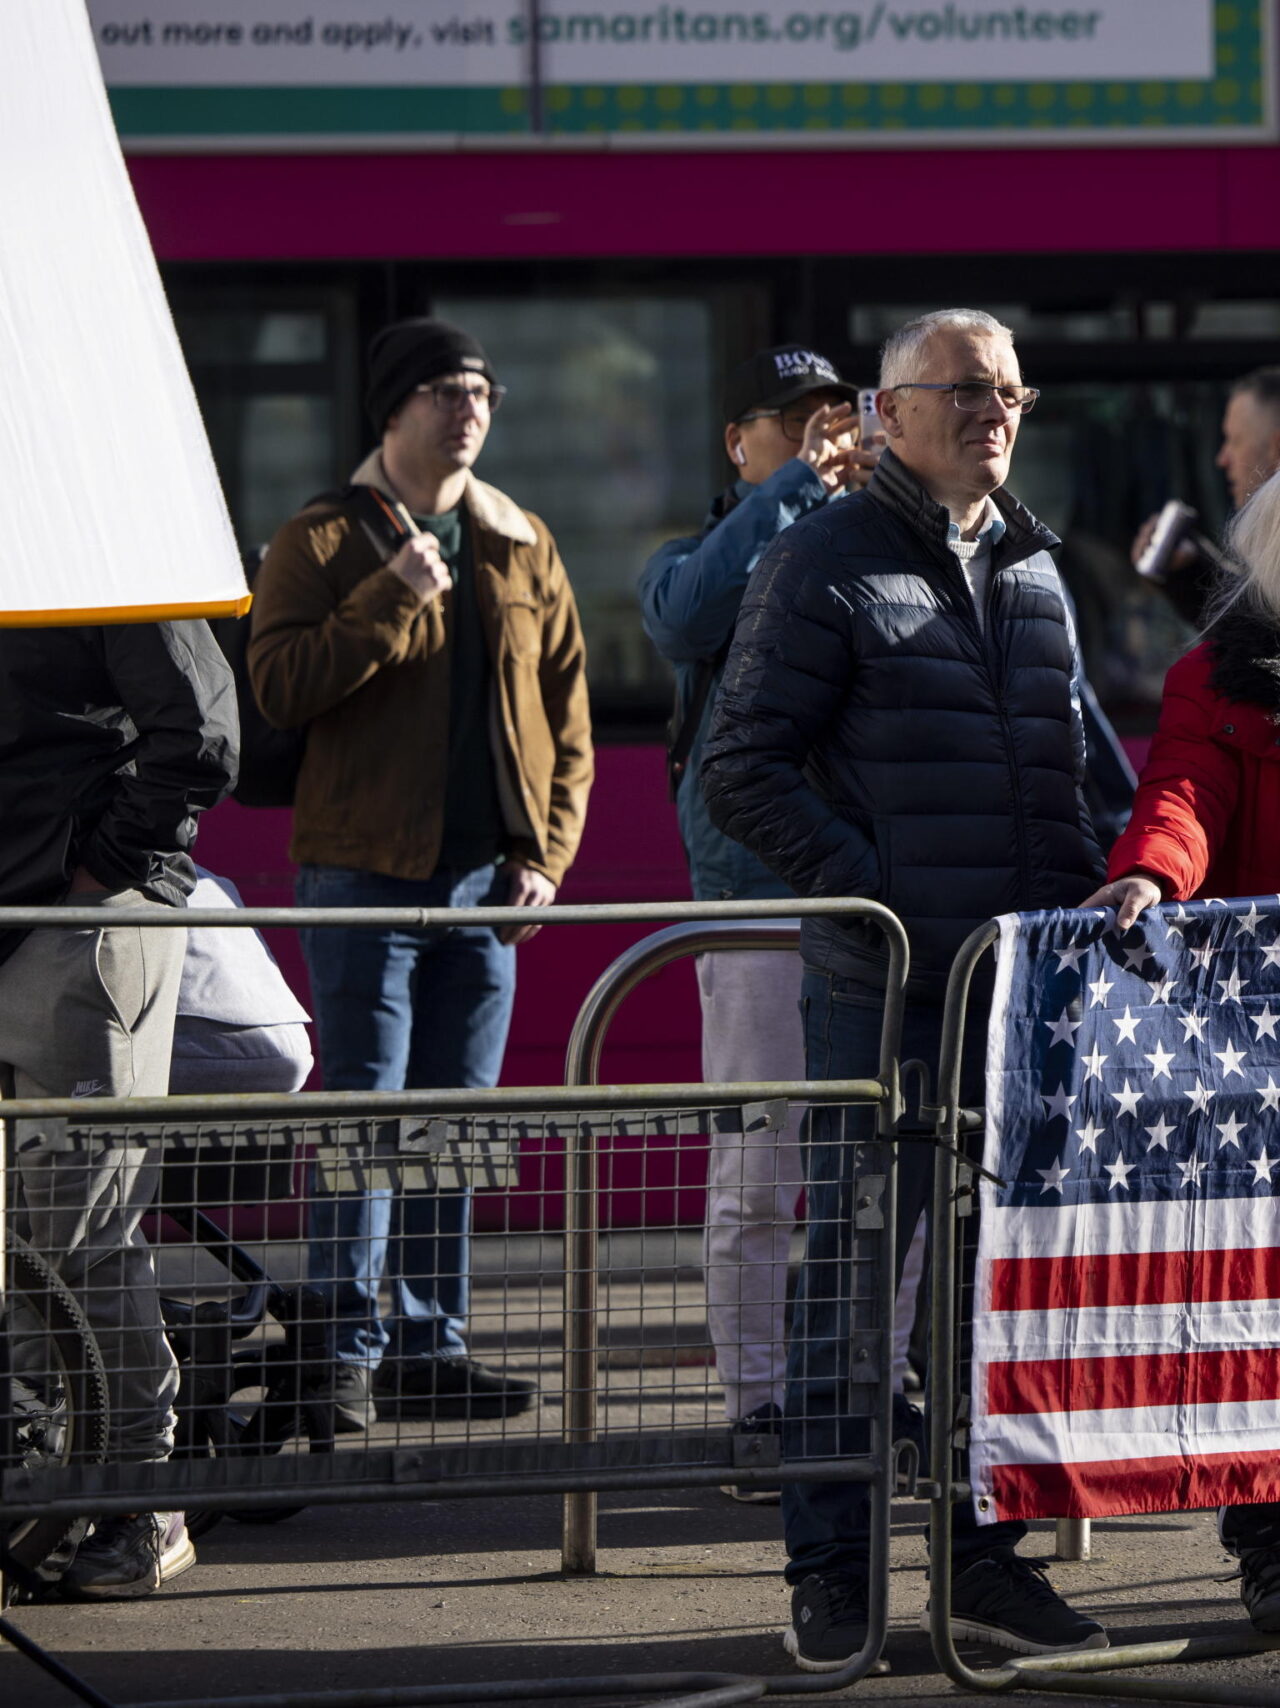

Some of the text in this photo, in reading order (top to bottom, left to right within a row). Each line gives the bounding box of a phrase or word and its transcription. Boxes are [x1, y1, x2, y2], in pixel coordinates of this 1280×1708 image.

[101, 2, 1103, 54] out more and apply, visit samaritans.org/volunteer
[75, 1079, 98, 1094] NIKE
